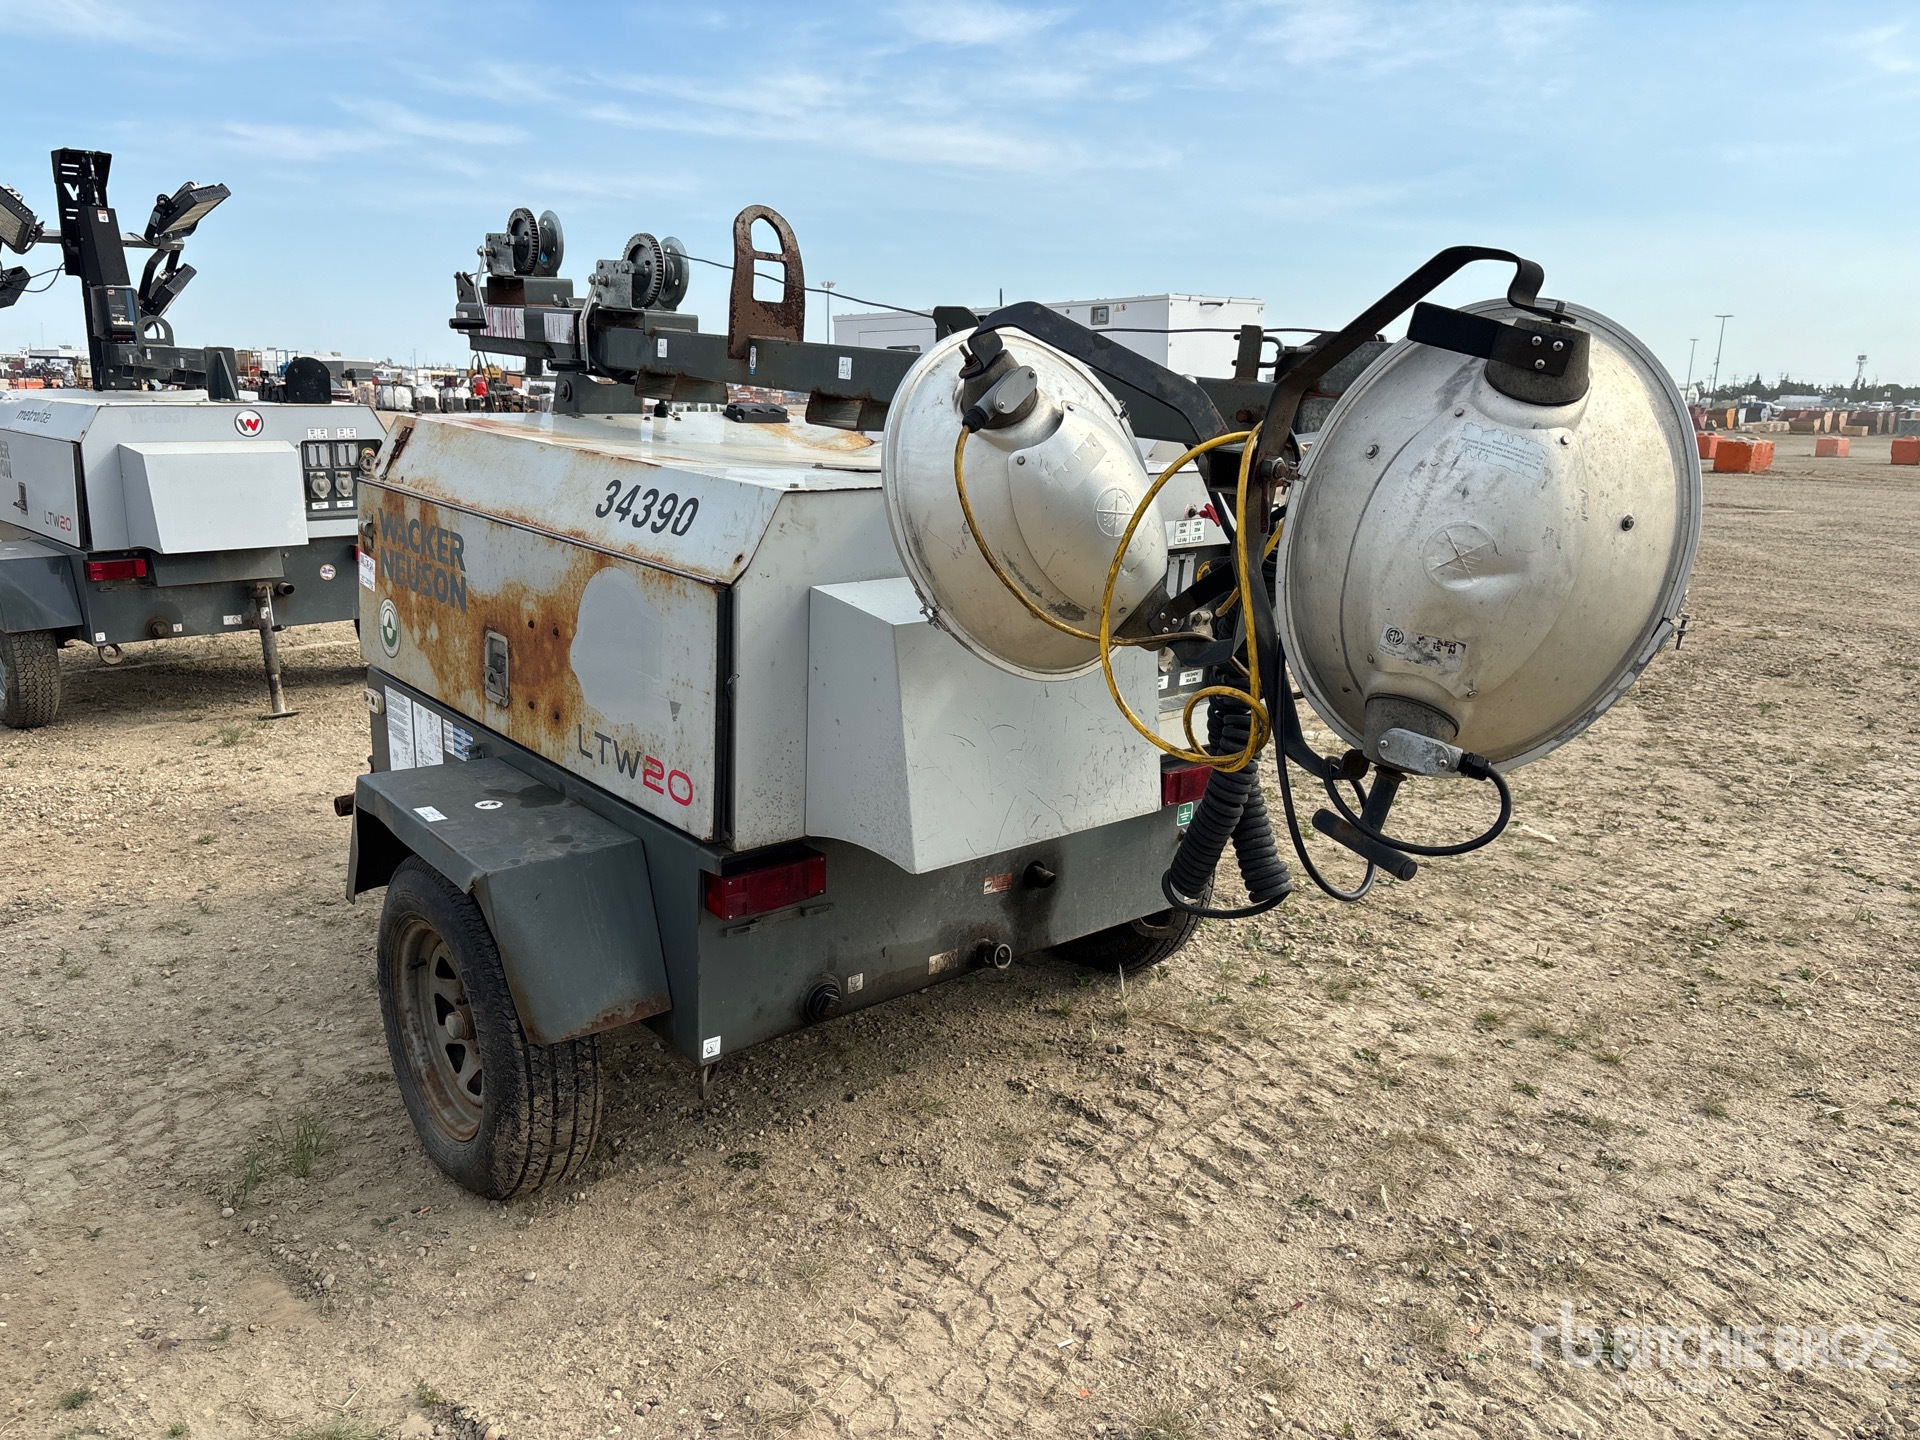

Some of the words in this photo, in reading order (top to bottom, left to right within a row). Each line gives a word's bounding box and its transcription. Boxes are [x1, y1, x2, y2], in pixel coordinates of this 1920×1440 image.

[44, 511, 72, 532] LTW20
[378, 507, 467, 572] WACKER
[595, 479, 699, 536] 34390
[380, 546, 467, 613] NEUSON
[578, 723, 693, 807] LTW20
